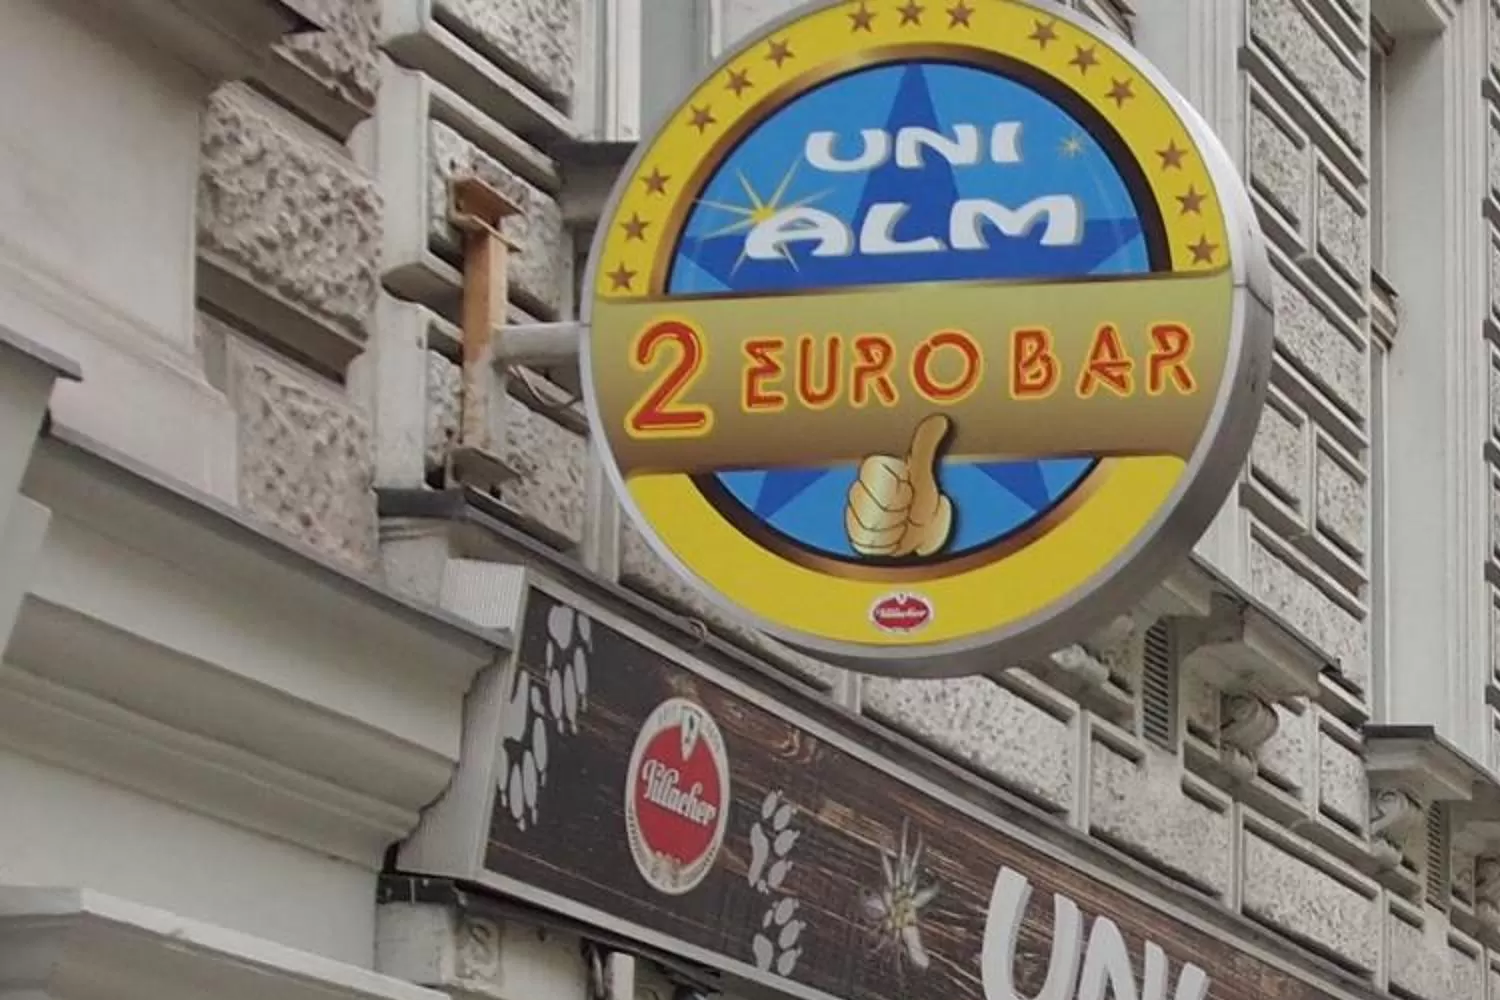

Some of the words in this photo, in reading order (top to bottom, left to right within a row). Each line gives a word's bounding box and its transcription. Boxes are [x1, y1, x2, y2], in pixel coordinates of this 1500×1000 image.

[804, 120, 1023, 171] UNI
[743, 194, 1083, 260] ALM
[627, 320, 712, 437] 2
[742, 332, 984, 410] EURO
[1010, 322, 1197, 401] BAR
